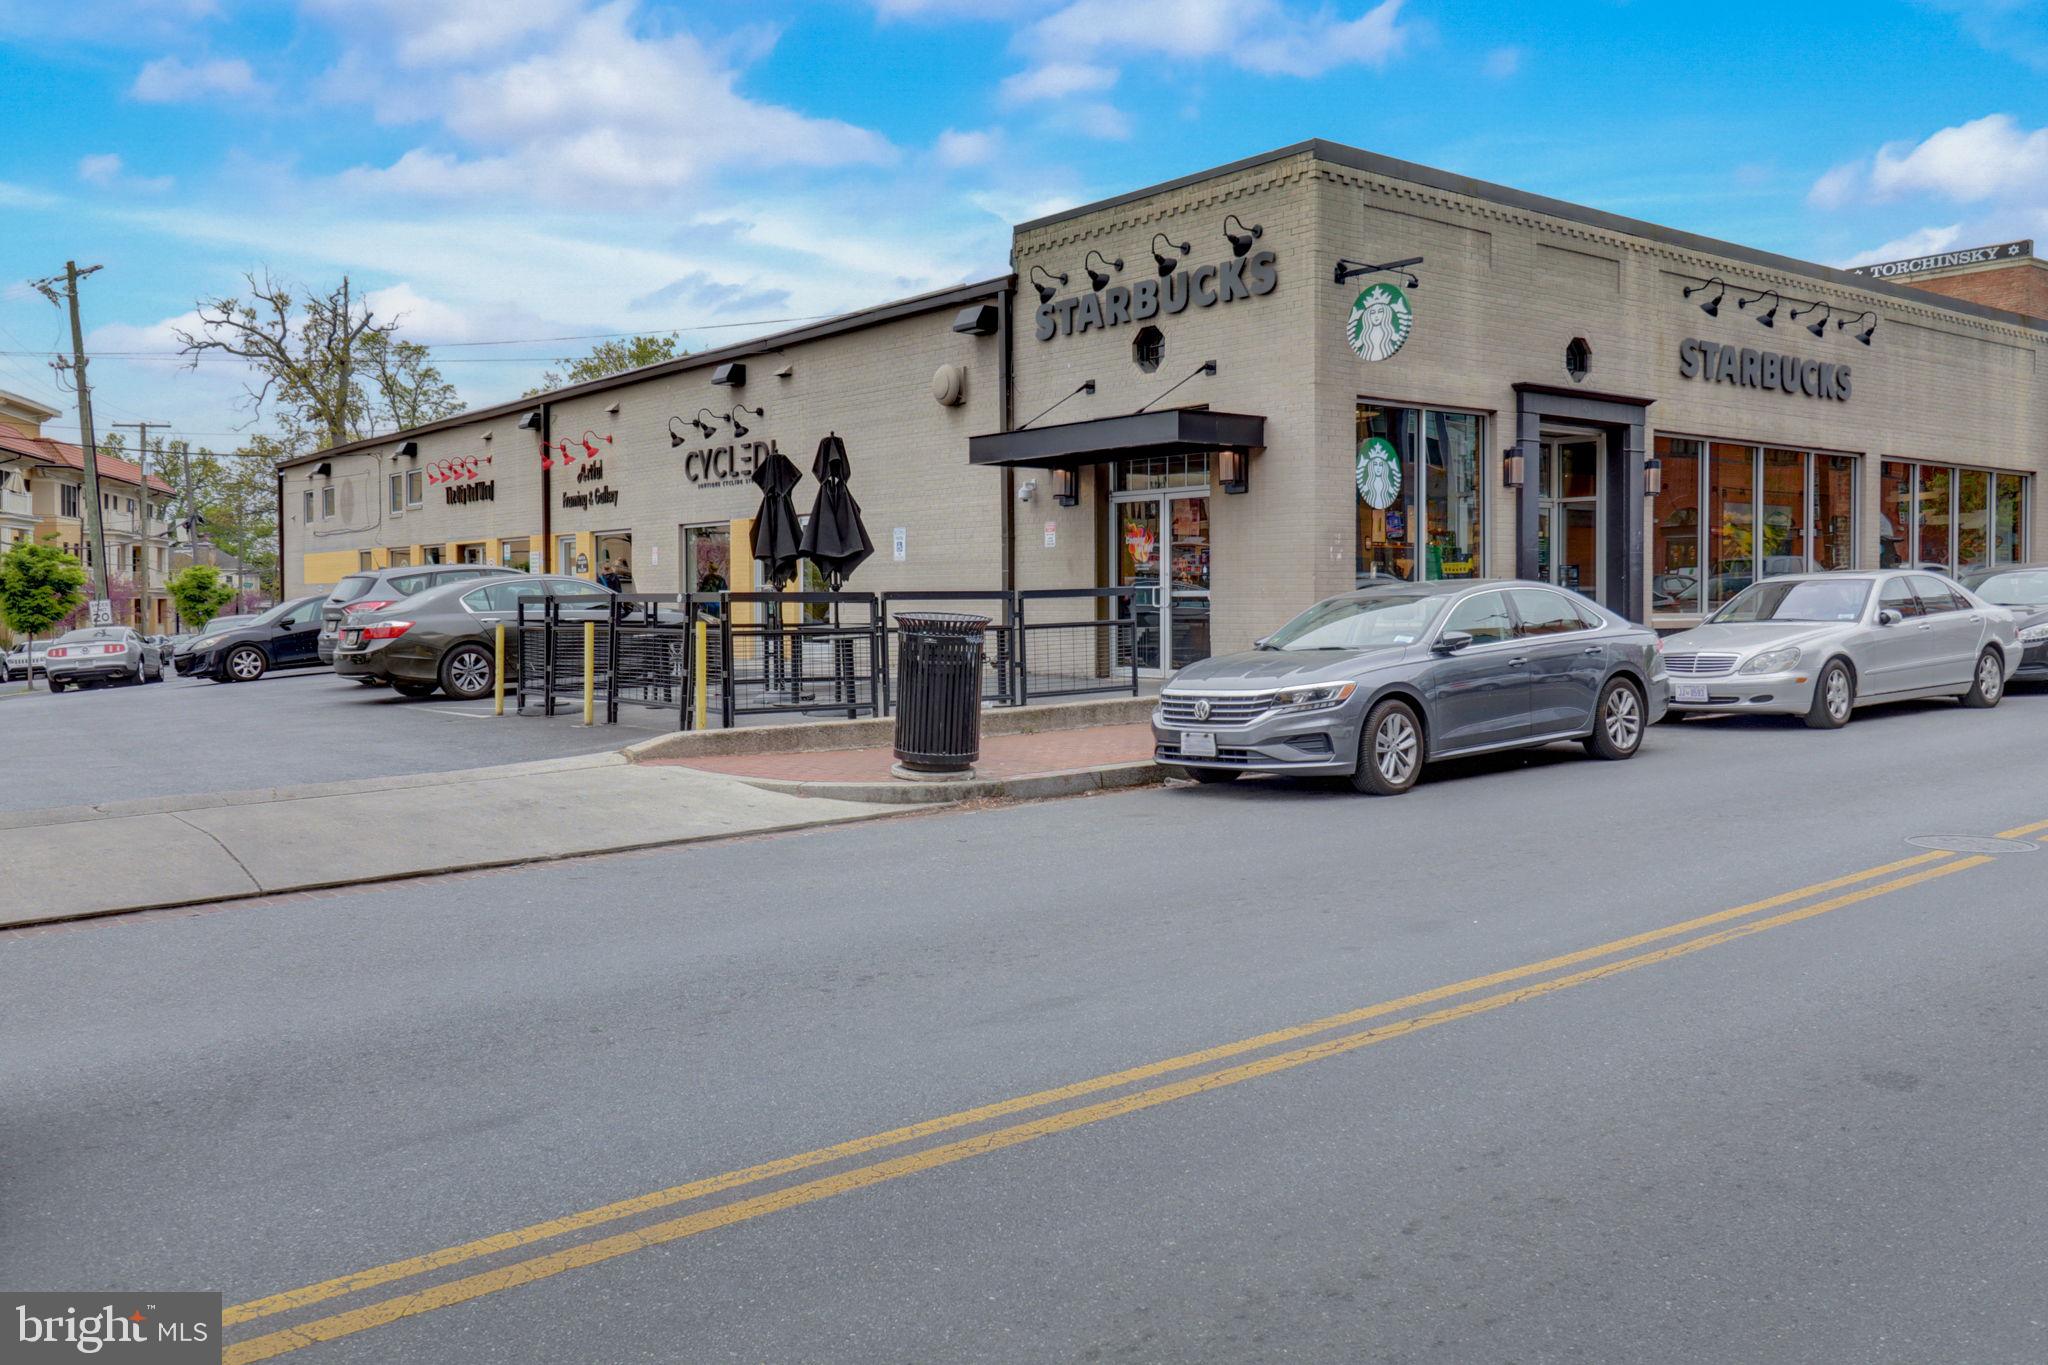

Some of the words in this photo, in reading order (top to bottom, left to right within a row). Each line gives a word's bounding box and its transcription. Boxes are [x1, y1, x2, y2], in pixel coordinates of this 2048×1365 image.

[1870, 246, 2000, 278] TORCHINSKY
[1035, 251, 1278, 342] STARBUCKS
[1679, 337, 1853, 402] STARBUCKS
[577, 459, 603, 483] Artful
[562, 491, 587, 511] Framing
[595, 484, 618, 507] Gallery
[93, 612, 110, 622] 20
